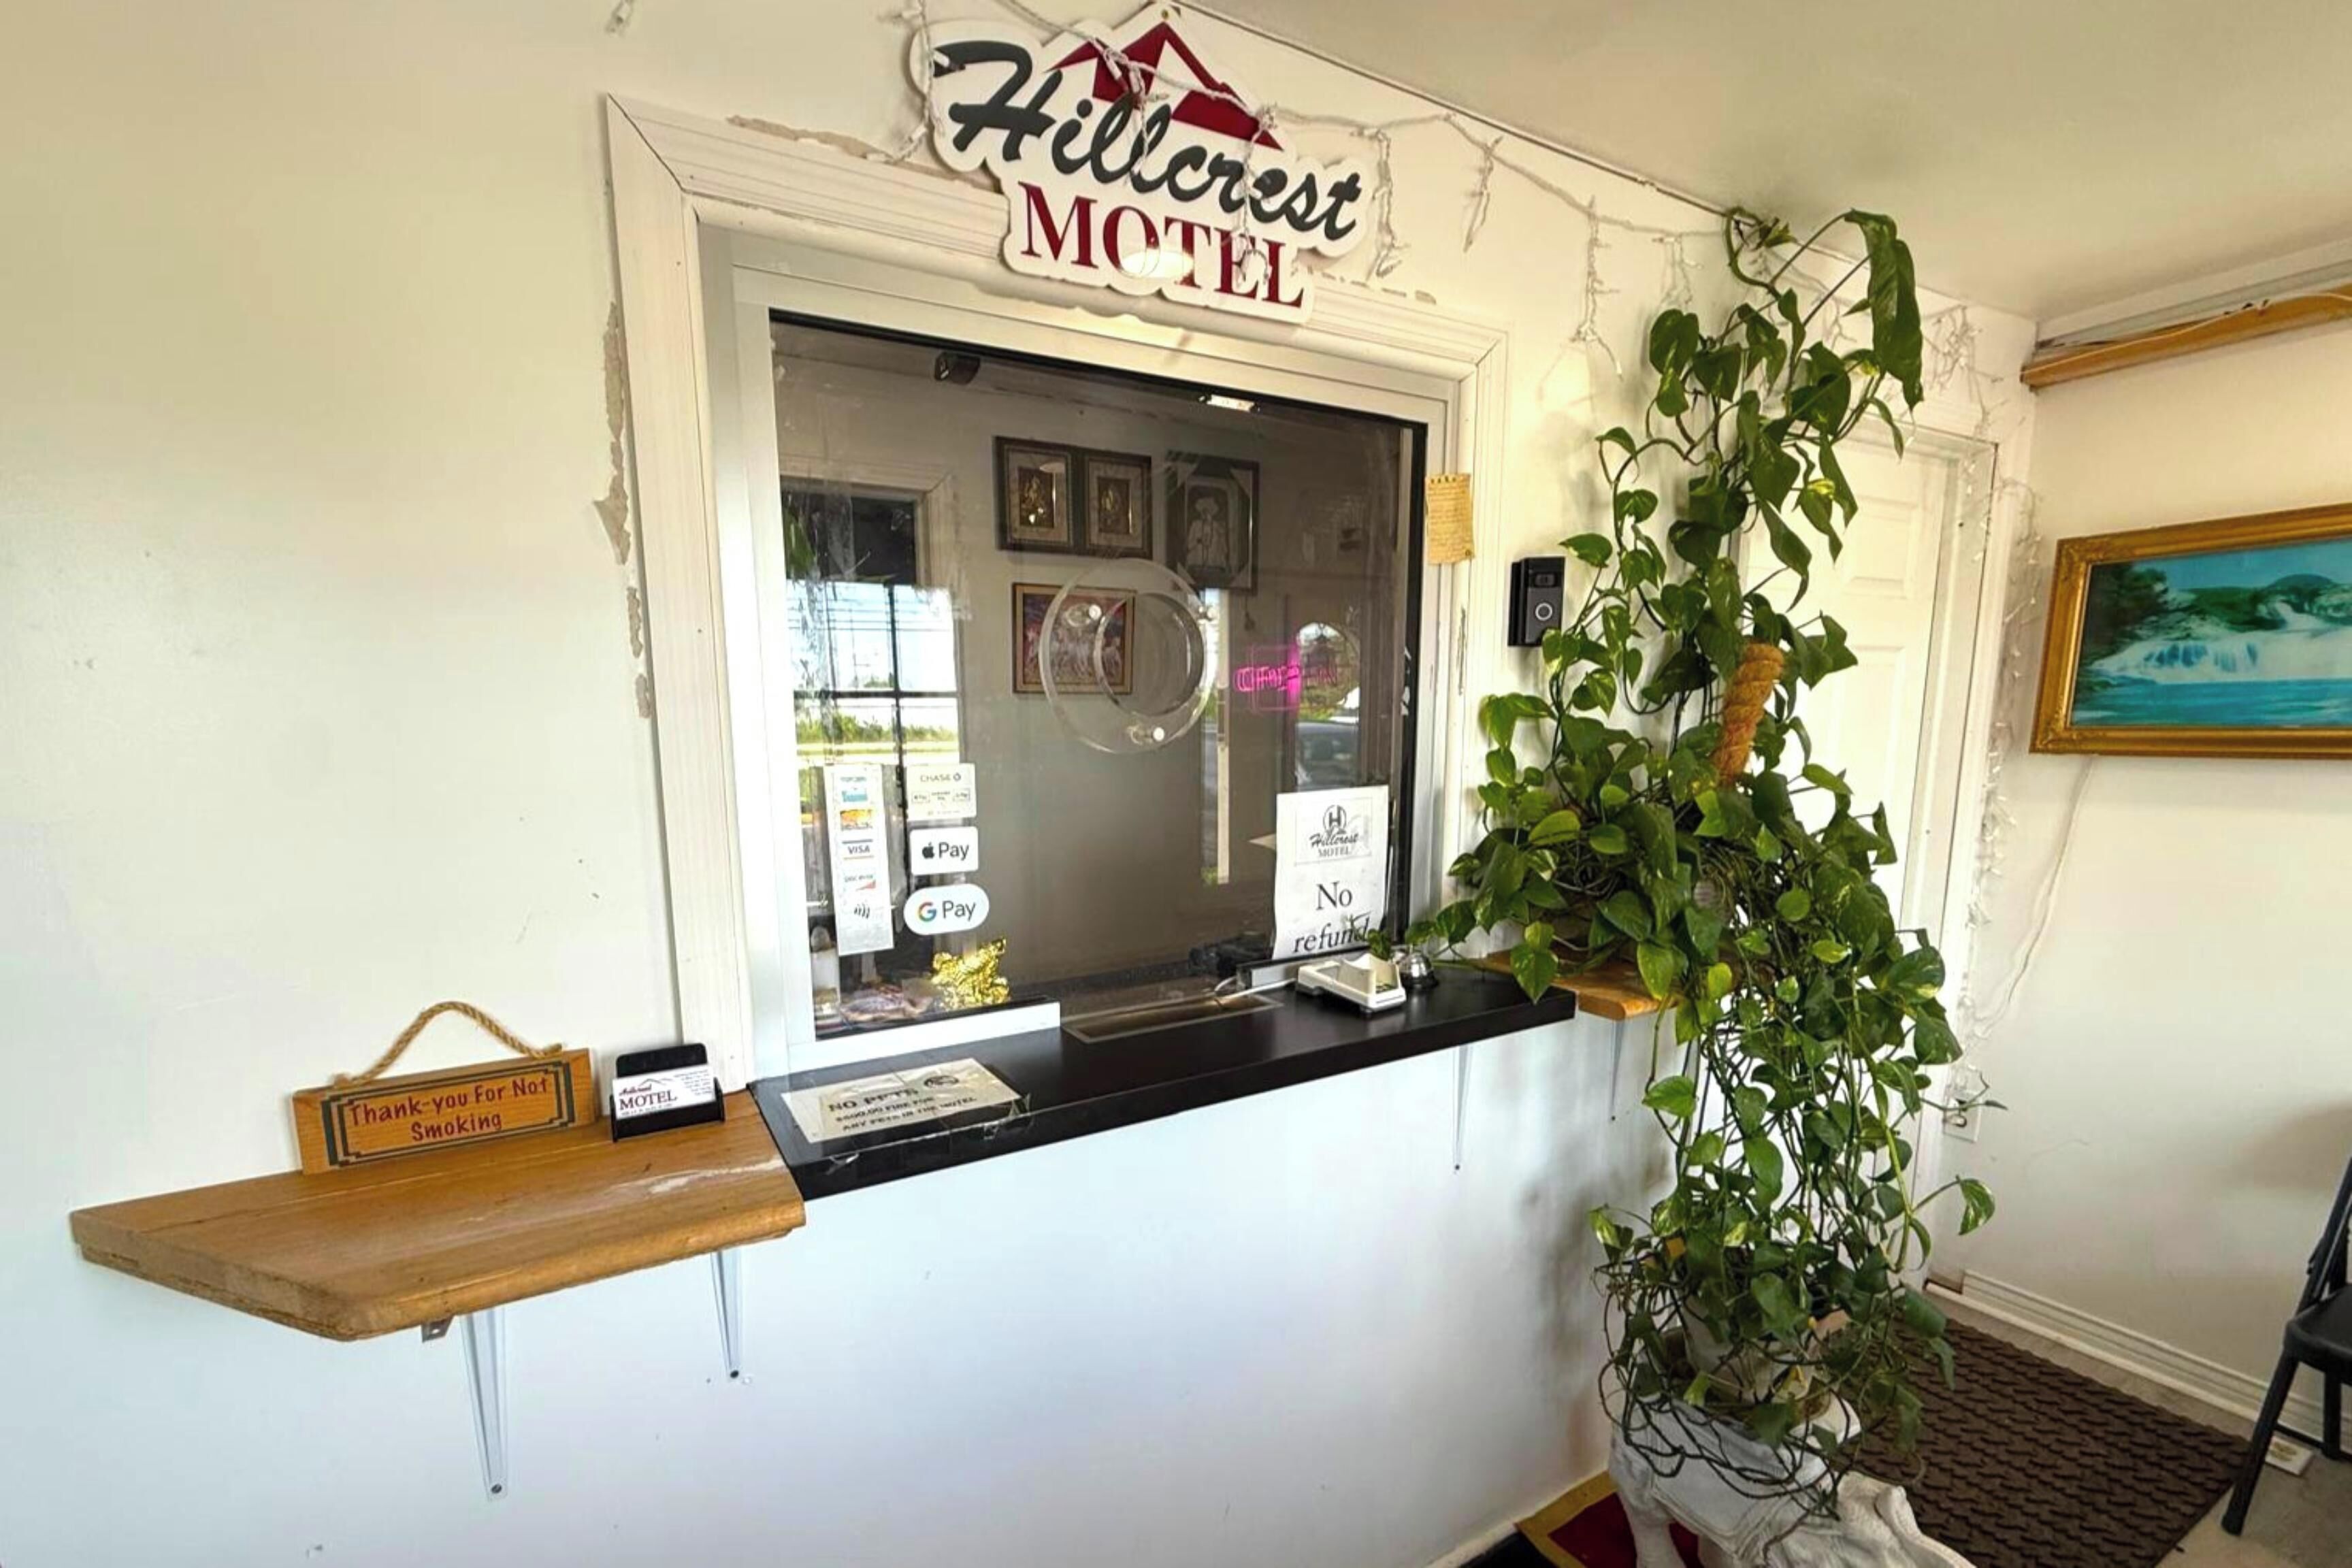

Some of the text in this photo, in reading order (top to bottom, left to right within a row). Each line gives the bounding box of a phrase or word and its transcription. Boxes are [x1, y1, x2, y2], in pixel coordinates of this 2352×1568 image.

[933, 39, 1360, 241] Hillcrest
[1018, 180, 1305, 308] MOTEL
[847, 845, 870, 854] VISA
[938, 841, 969, 861] Pay
[1316, 881, 1353, 911] No
[942, 900, 976, 922] Pay
[349, 1077, 548, 1126] Thank-you For Not
[619, 1089, 679, 1111] MOTEL
[828, 1100, 858, 1112] NO
[410, 1113, 502, 1142] Smoking
